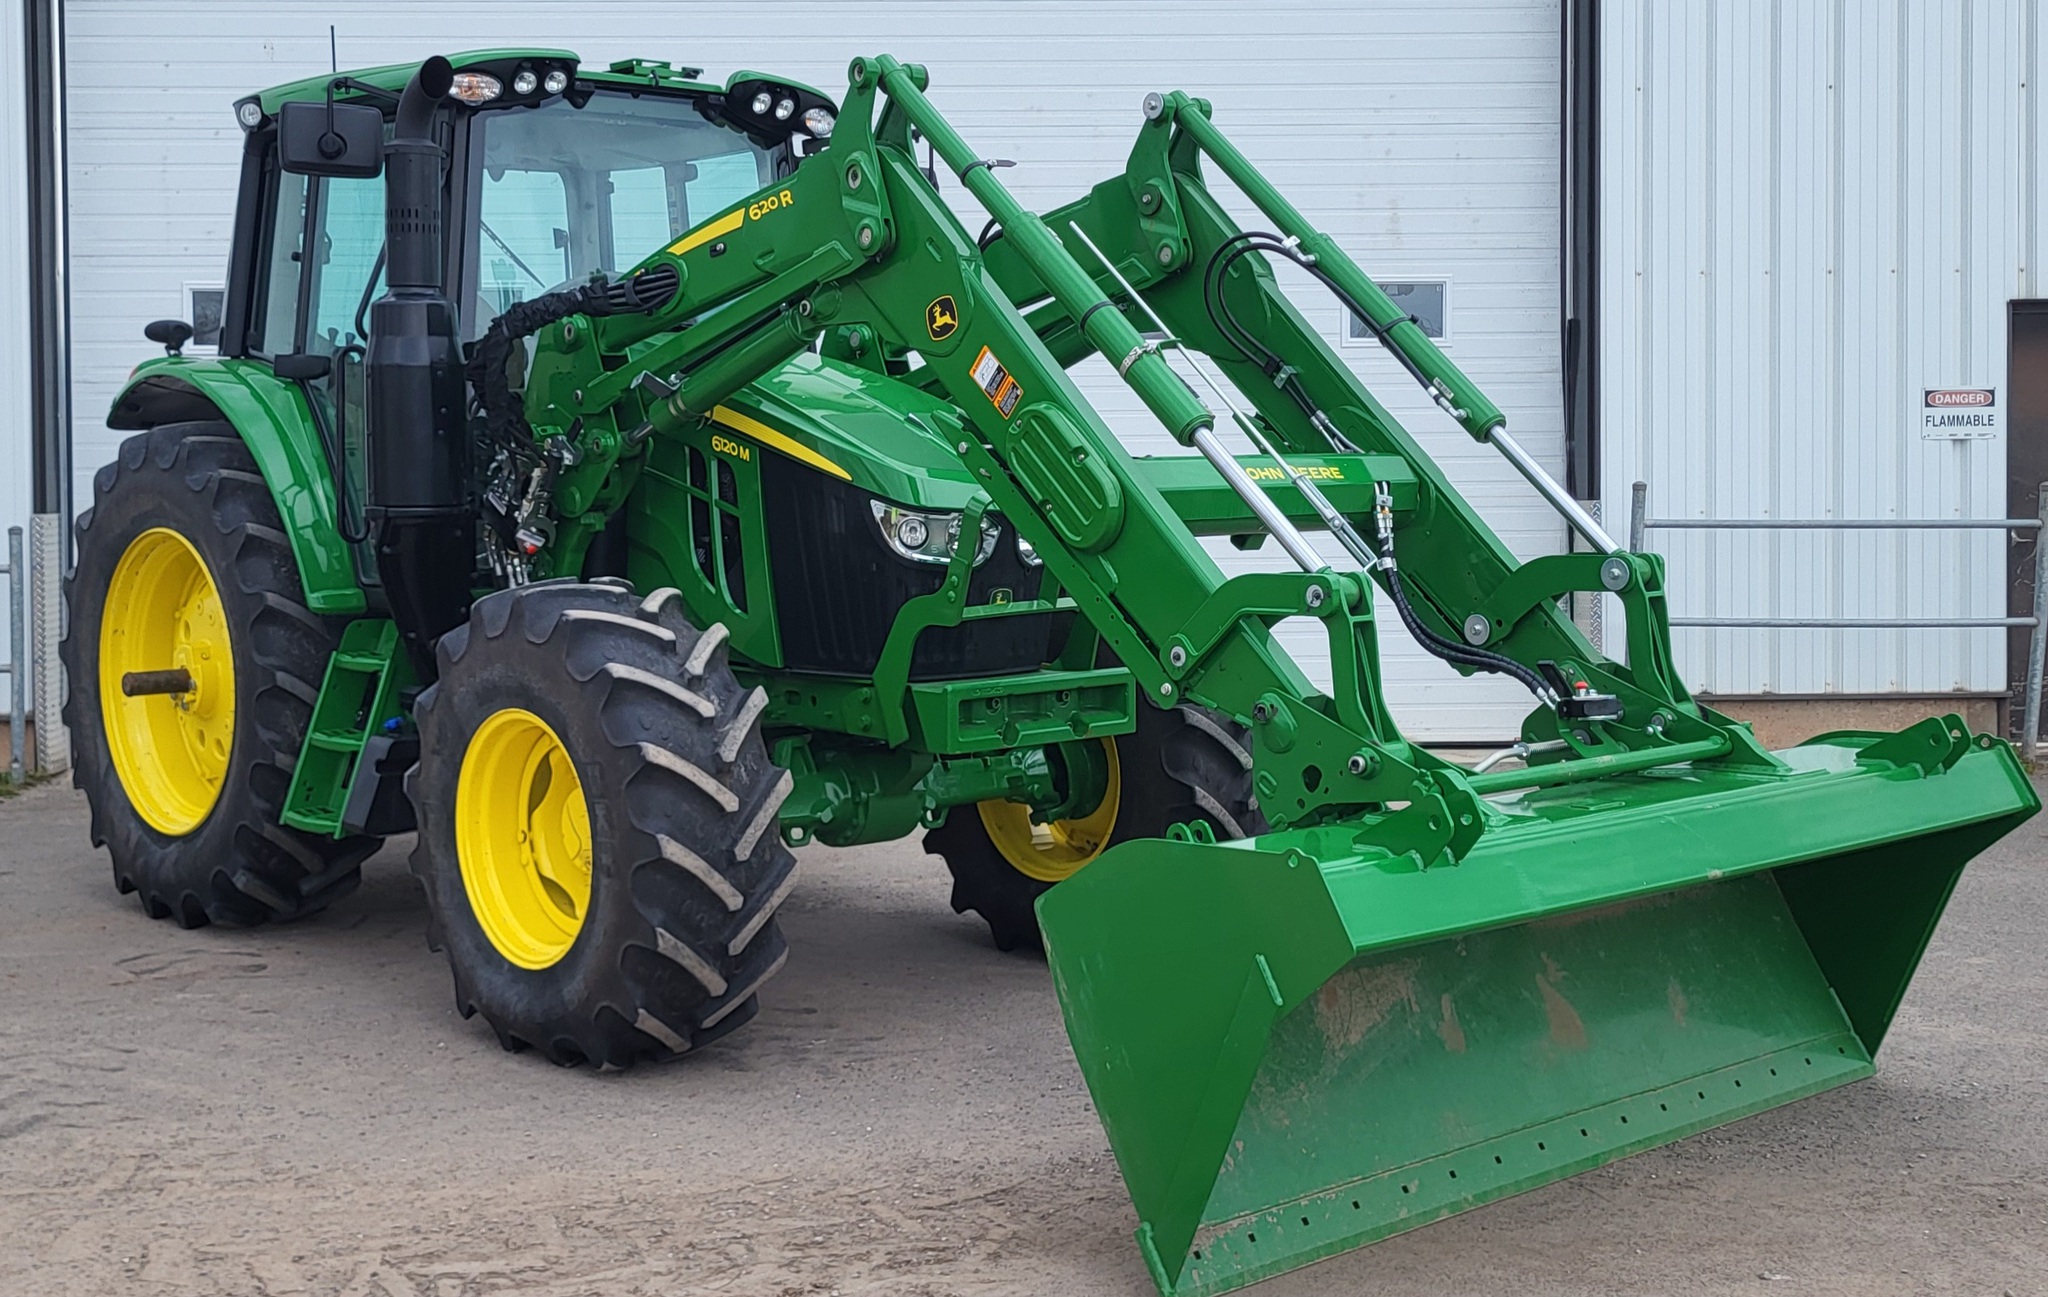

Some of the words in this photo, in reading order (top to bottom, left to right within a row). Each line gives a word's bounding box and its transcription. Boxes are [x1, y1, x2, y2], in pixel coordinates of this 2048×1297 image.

[749, 196, 779, 221] 620
[779, 189, 793, 208] R
[1935, 393, 1985, 404] DANGER
[1925, 414, 1995, 428] FLAMMABLE
[711, 435, 738, 456] 6120
[739, 445, 750, 462] M
[1245, 467, 1286, 480] OHN
